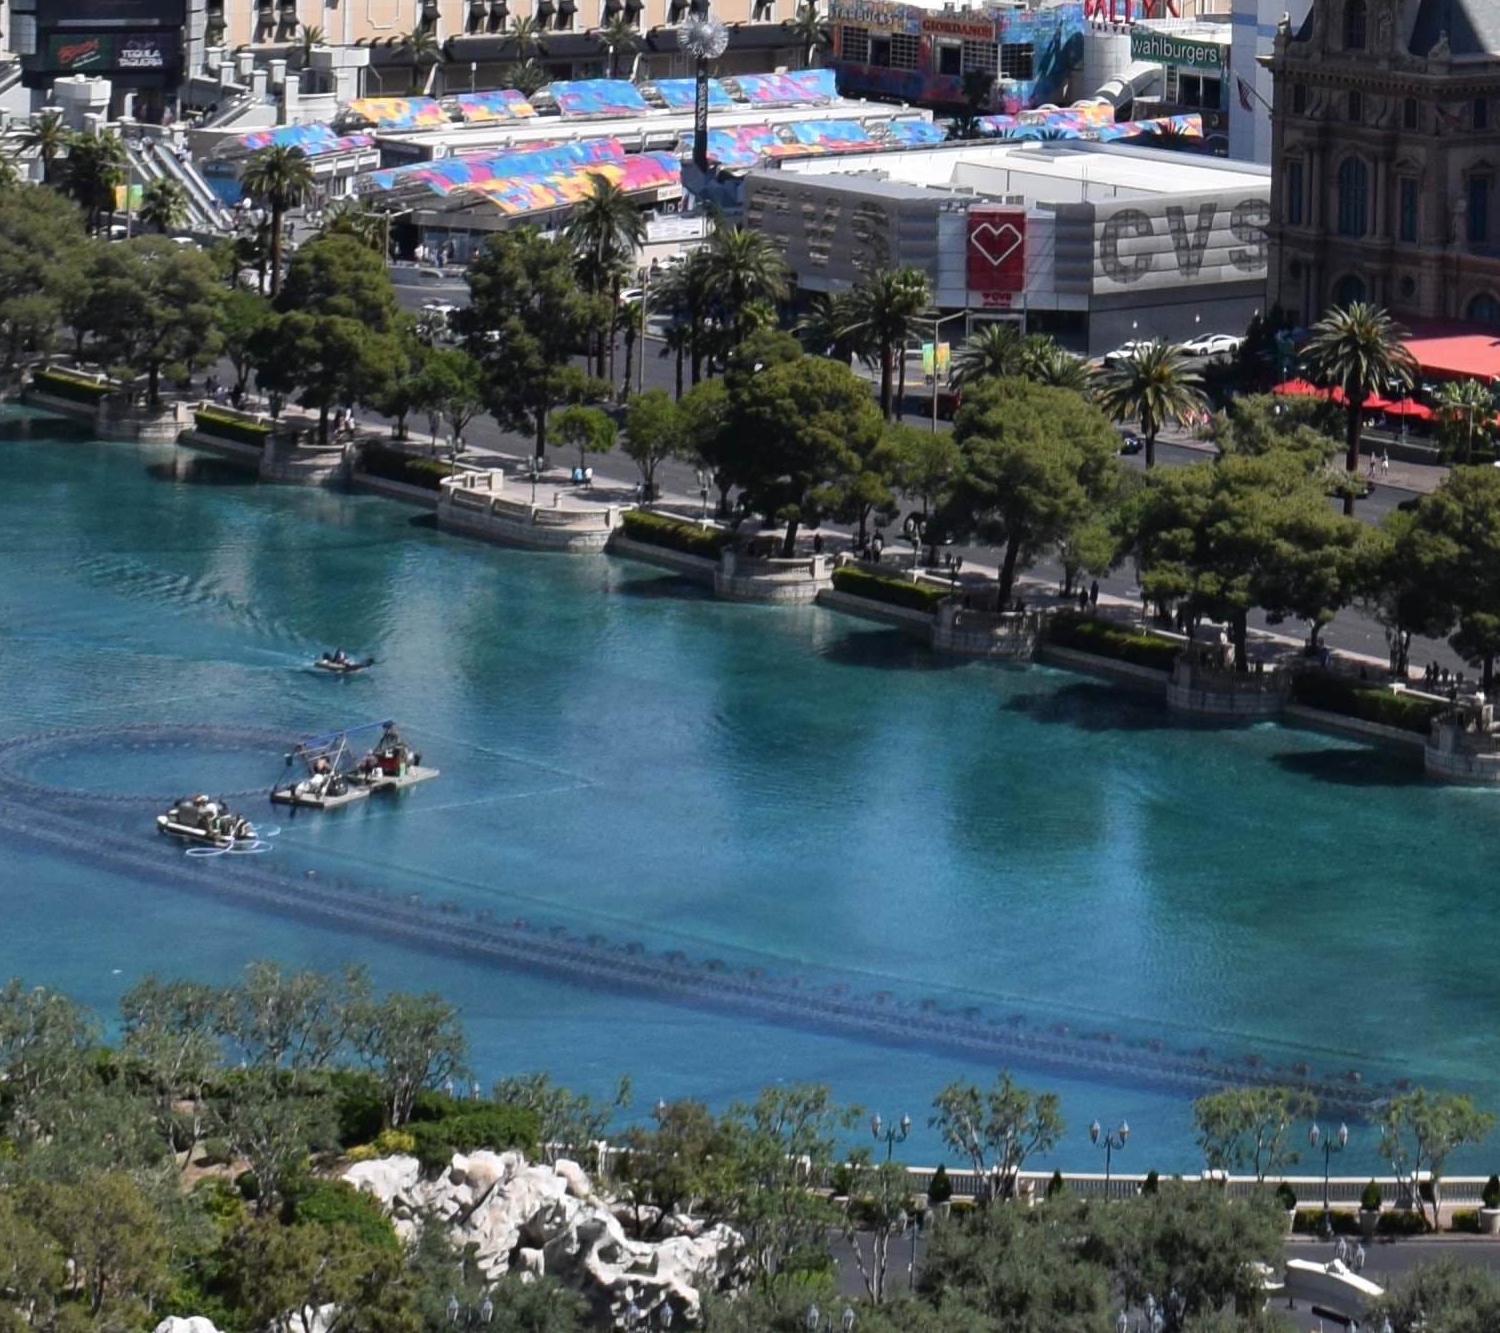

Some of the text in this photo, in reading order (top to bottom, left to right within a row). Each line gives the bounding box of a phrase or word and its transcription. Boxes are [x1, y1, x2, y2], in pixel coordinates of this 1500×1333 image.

[828, 6, 893, 24] STARBUCKS
[922, 18, 993, 38] GIORDANO'S
[1132, 37, 1218, 64] wahlburgers
[698, 83, 707, 131] SWAROVSKI
[1102, 197, 1271, 285] CVS
